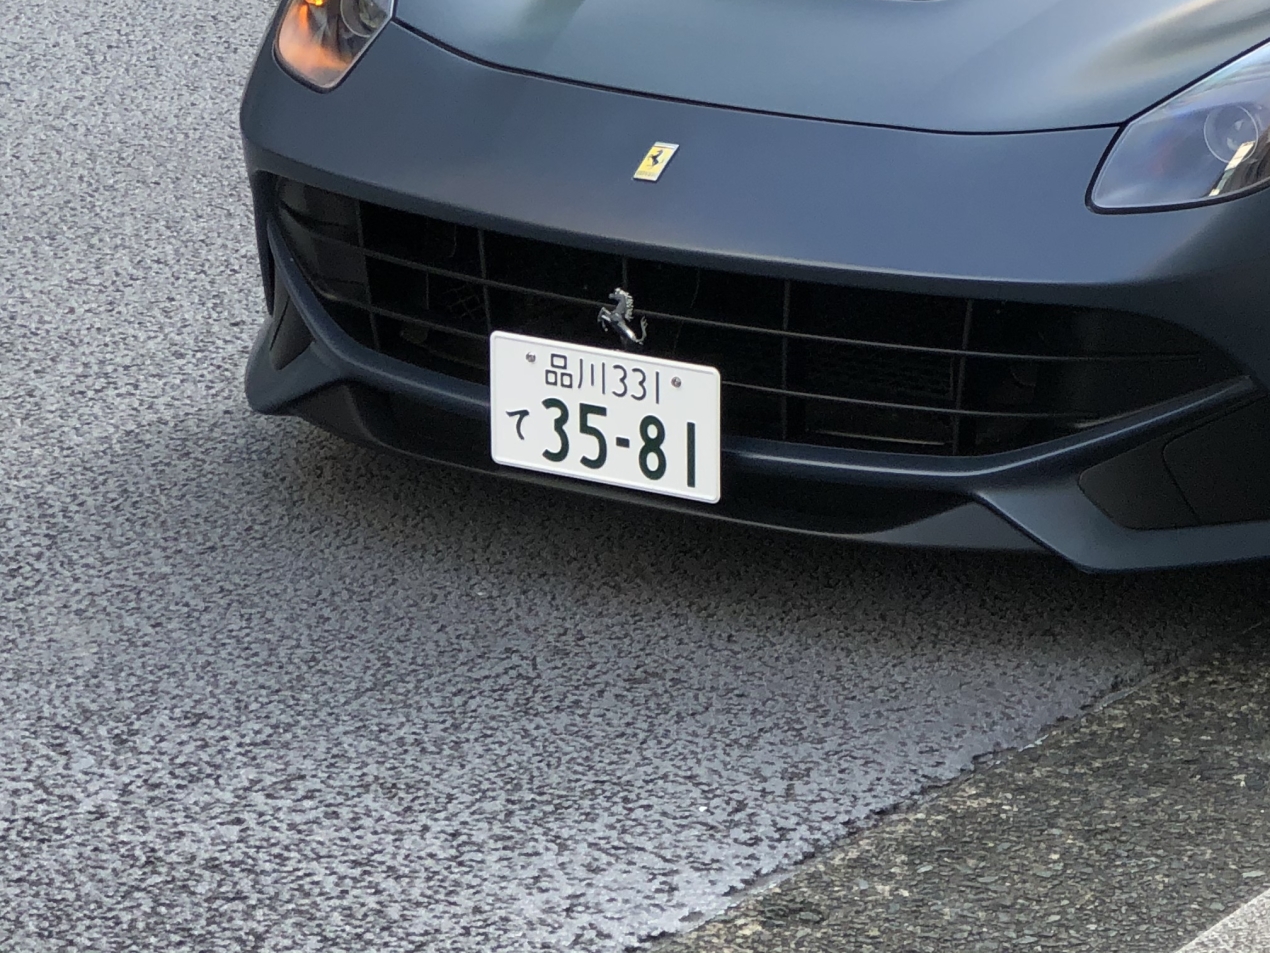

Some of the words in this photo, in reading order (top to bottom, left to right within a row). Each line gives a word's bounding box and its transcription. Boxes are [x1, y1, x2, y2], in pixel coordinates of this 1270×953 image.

[545, 353, 606, 395] 品川
[611, 364, 660, 404] 331
[505, 409, 530, 440] て
[541, 397, 696, 488] 35-81
